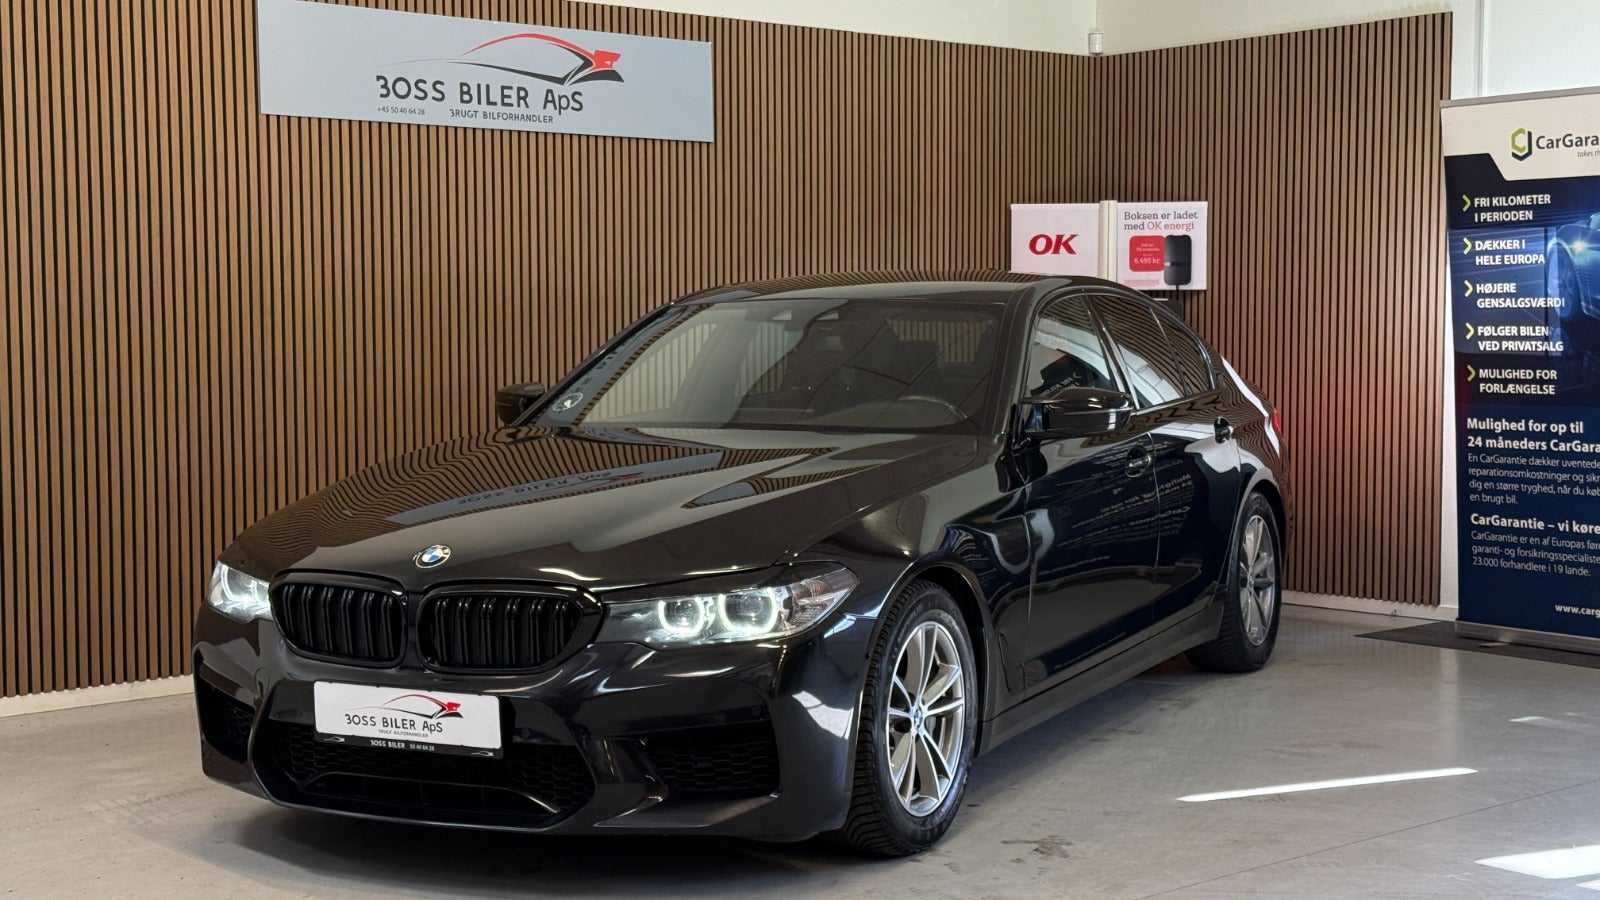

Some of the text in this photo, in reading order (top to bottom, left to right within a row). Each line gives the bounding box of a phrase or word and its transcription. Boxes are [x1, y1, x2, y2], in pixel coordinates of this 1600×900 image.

[459, 82, 530, 109] BILER
[542, 88, 584, 116] ApS
[390, 106, 399, 114] 50
[482, 111, 554, 124] BILFORHANDLER
[1535, 133, 1600, 150] CarGara
[1474, 194, 1552, 208] FRI KILOMETER
[1124, 211, 1158, 221] Boksen
[1173, 211, 1198, 220] ladet
[1474, 210, 1534, 223] I PERIODEN
[1124, 221, 1195, 232] med OK energi
[1029, 234, 1079, 255] OK
[1475, 239, 1526, 251] DÆKKER I
[1475, 254, 1545, 266] HELE EUROPA
[1476, 283, 1517, 294] HØJERE
[1476, 297, 1565, 309] GENSALGSVÆRDI
[1477, 326, 1549, 337] FØLGER BILEN
[1478, 341, 1564, 352] VED PRIVATSALG
[1479, 369, 1557, 380] MULIGHED FOR
[1479, 383, 1556, 395] FORLÆNGELSE
[1466, 418, 1584, 435] Mulighed for op til
[1467, 436, 1483, 448] 24
[1485, 436, 1547, 451] måneders
[1468, 453, 1479, 463] En
[1480, 453, 1527, 465] CarGarantie
[1528, 456, 1560, 467] dækker
[1468, 467, 1571, 482] reparationsomkostninger
[1572, 473, 1584, 484] og
[1469, 479, 1482, 490] dig
[1483, 481, 1495, 490] en
[1496, 481, 1520, 492] større
[1521, 482, 1556, 495] tryghed,
[1557, 485, 1571, 495] når
[1572, 485, 1585, 496] du
[1469, 493, 1518, 506] en brugt bil.
[1470, 513, 1545, 530] CarGarantie
[1557, 520, 1569, 532] vi
[1471, 531, 1518, 543] CarGarantie
[1519, 535, 1528, 544] er
[1529, 537, 1541, 545] en
[1542, 536, 1551, 546] af
[1552, 538, 1585, 550] Europas
[1471, 545, 1502, 555] garanti-
[1504, 547, 1516, 558] og
[1472, 556, 1499, 567] 23.000
[1500, 559, 1547, 573] forhandlere
[1553, 564, 1564, 574] 19
[1565, 565, 1591, 577] lande.
[382, 717, 416, 730] BILER
[422, 720, 443, 734] ApS
[387, 741, 405, 749] BILER
